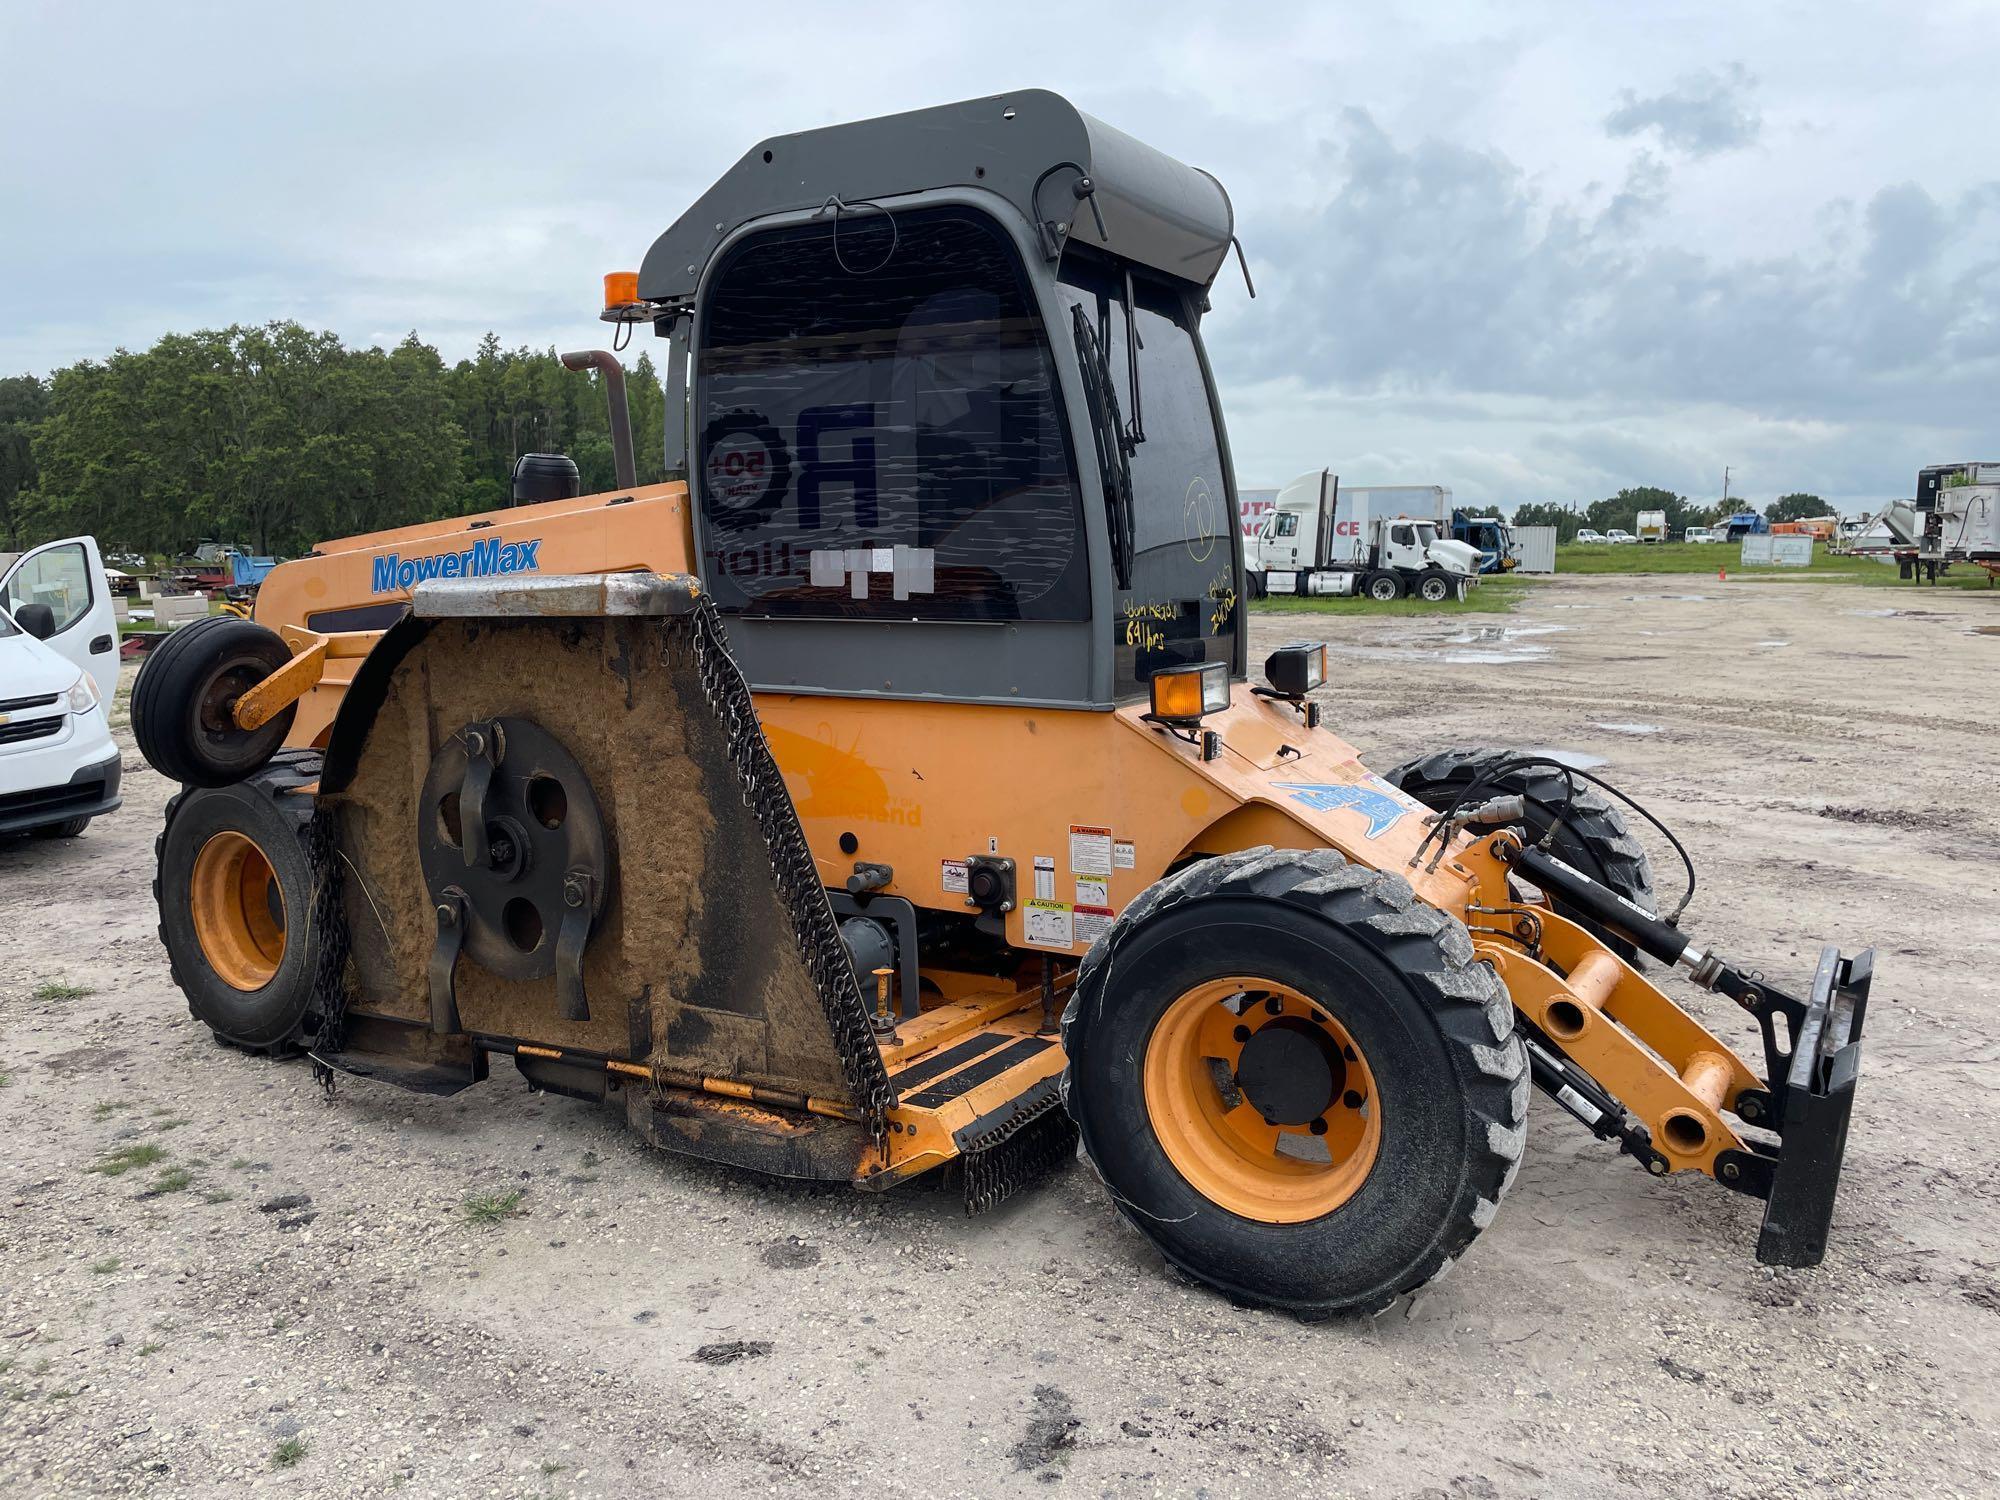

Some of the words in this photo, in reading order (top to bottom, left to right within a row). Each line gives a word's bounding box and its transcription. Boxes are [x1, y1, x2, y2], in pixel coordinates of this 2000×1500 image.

[372, 537, 542, 594] MowerMax
[1149, 599, 1178, 621] Reads
[1037, 901, 1063, 909] CAUTION
